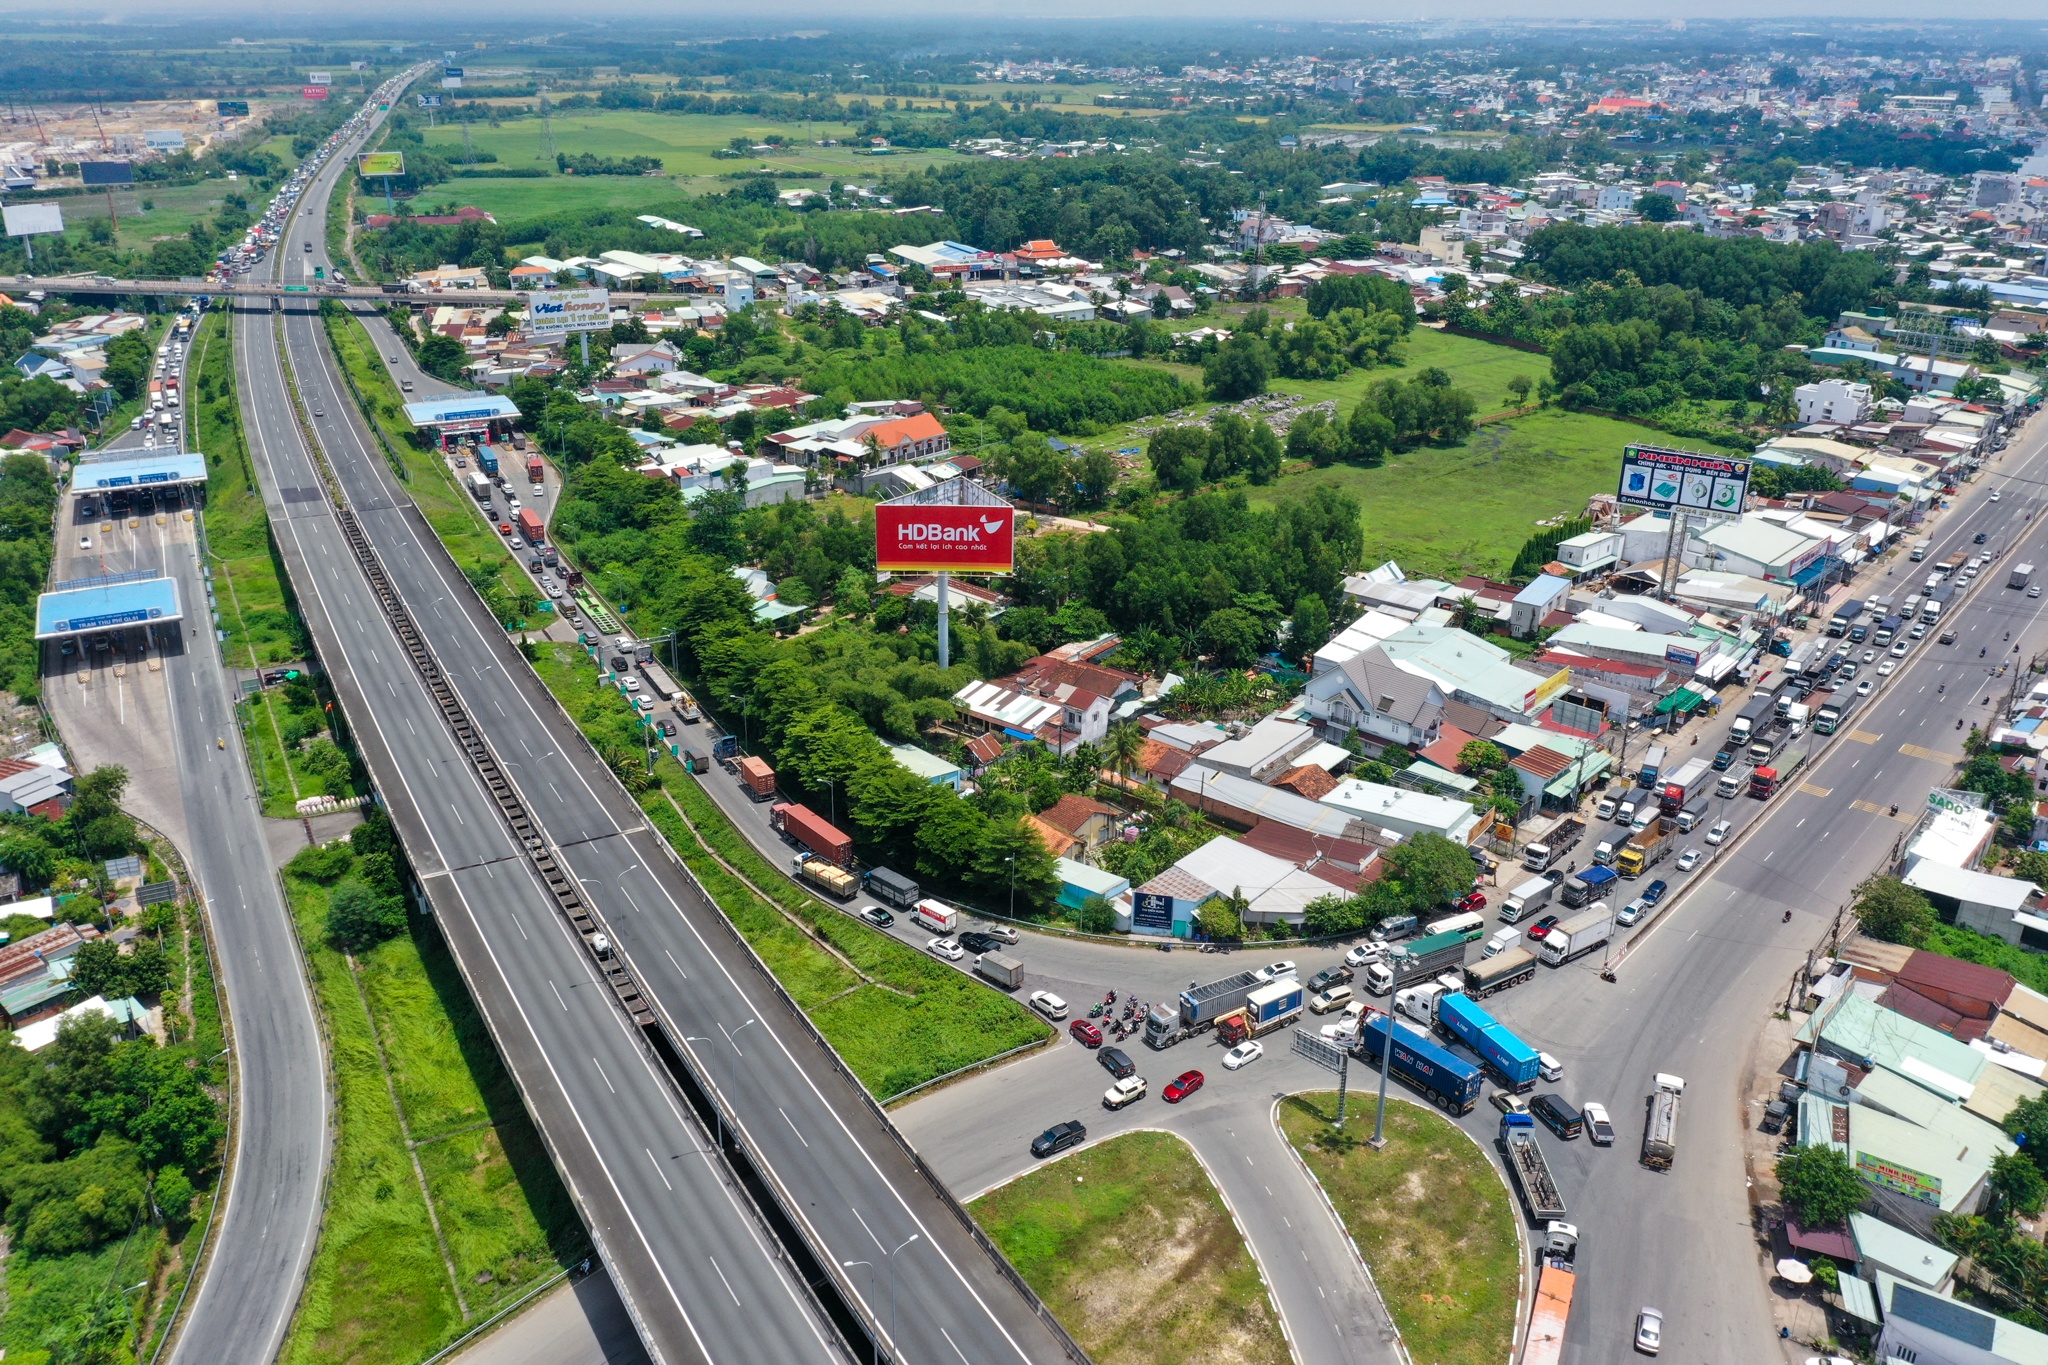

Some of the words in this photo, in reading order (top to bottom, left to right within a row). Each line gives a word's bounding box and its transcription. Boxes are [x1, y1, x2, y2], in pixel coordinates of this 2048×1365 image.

[1627, 496, 1665, 508] nhonhoa.vn
[898, 523, 981, 541] HDBank
[915, 542, 928, 550] kết
[1928, 793, 1964, 815] SADO
[1394, 1047, 1414, 1065] WAN
[1415, 1060, 1434, 1077] HAI
[1879, 1164, 1900, 1176] MINH
[1901, 1172, 1918, 1182] HUY
